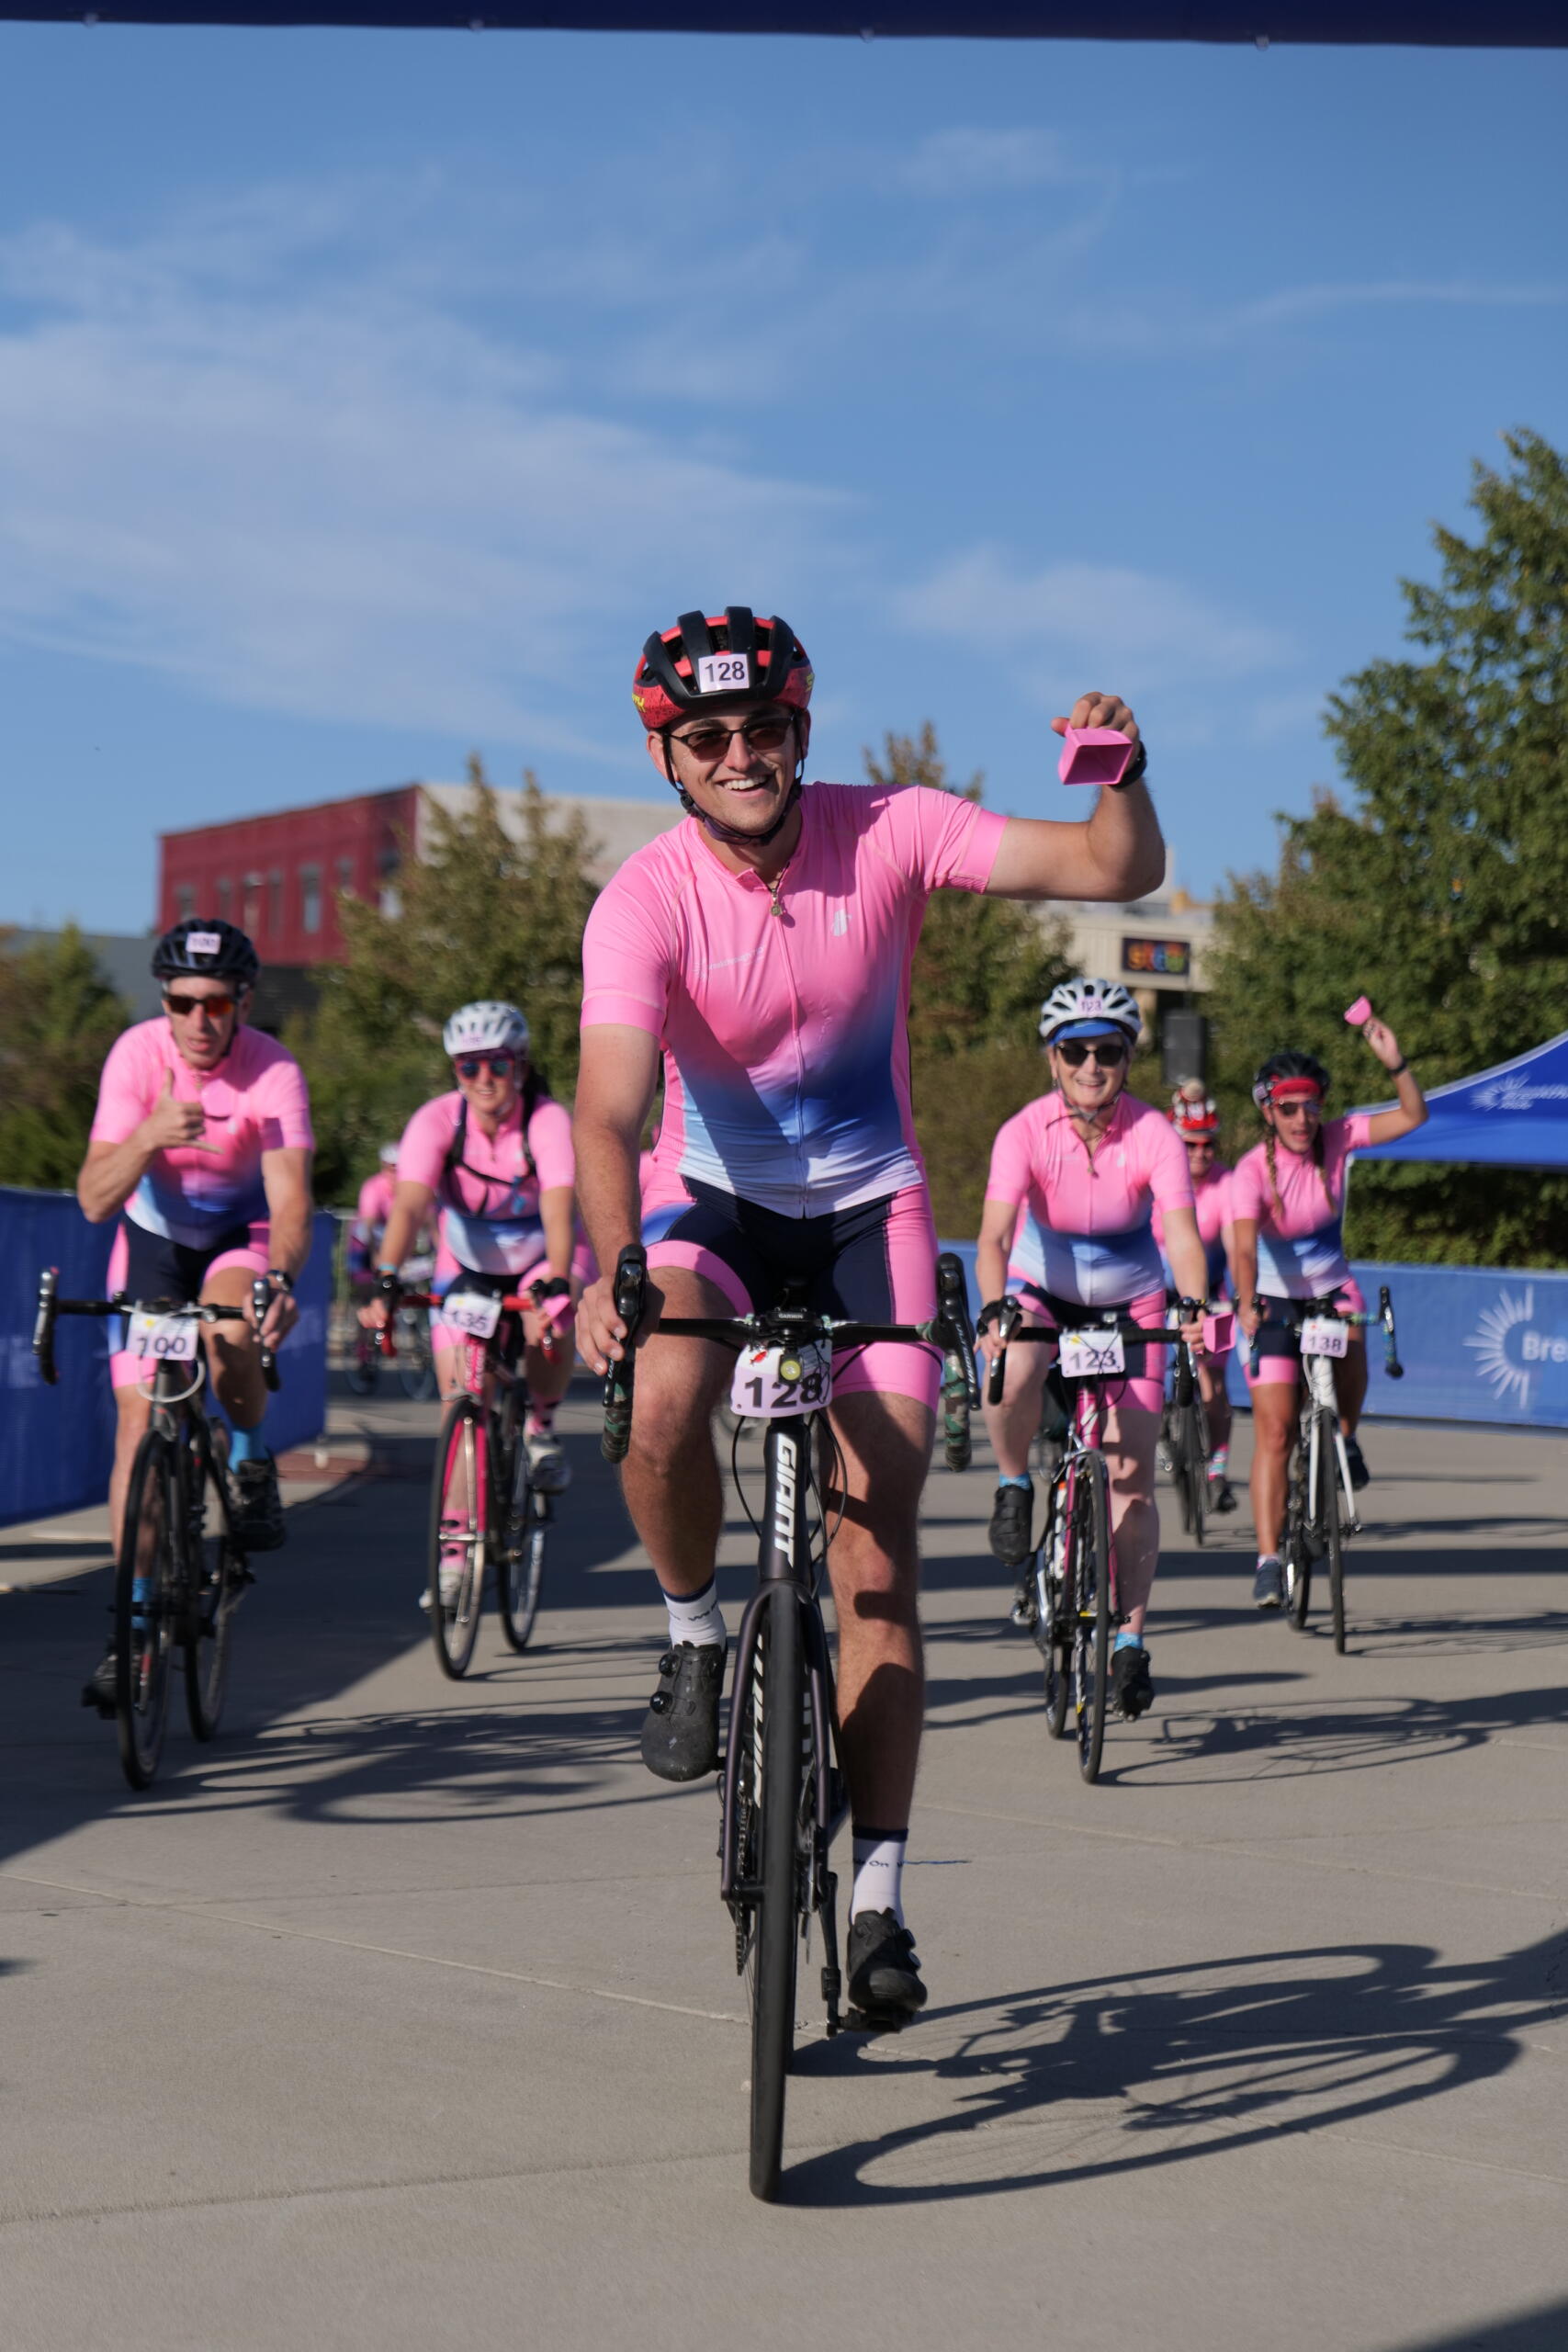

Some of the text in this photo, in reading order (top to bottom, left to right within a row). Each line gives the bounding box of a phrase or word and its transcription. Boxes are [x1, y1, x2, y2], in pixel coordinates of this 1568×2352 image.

[705, 661, 745, 683] 128
[136, 1337, 186, 1355] 700
[1309, 1336, 1342, 1353] 138
[1522, 1330, 1568, 1363] Bre
[1069, 1351, 1116, 1370] 123
[744, 1374, 822, 1409] 128
[774, 1433, 797, 1568] GIANT
